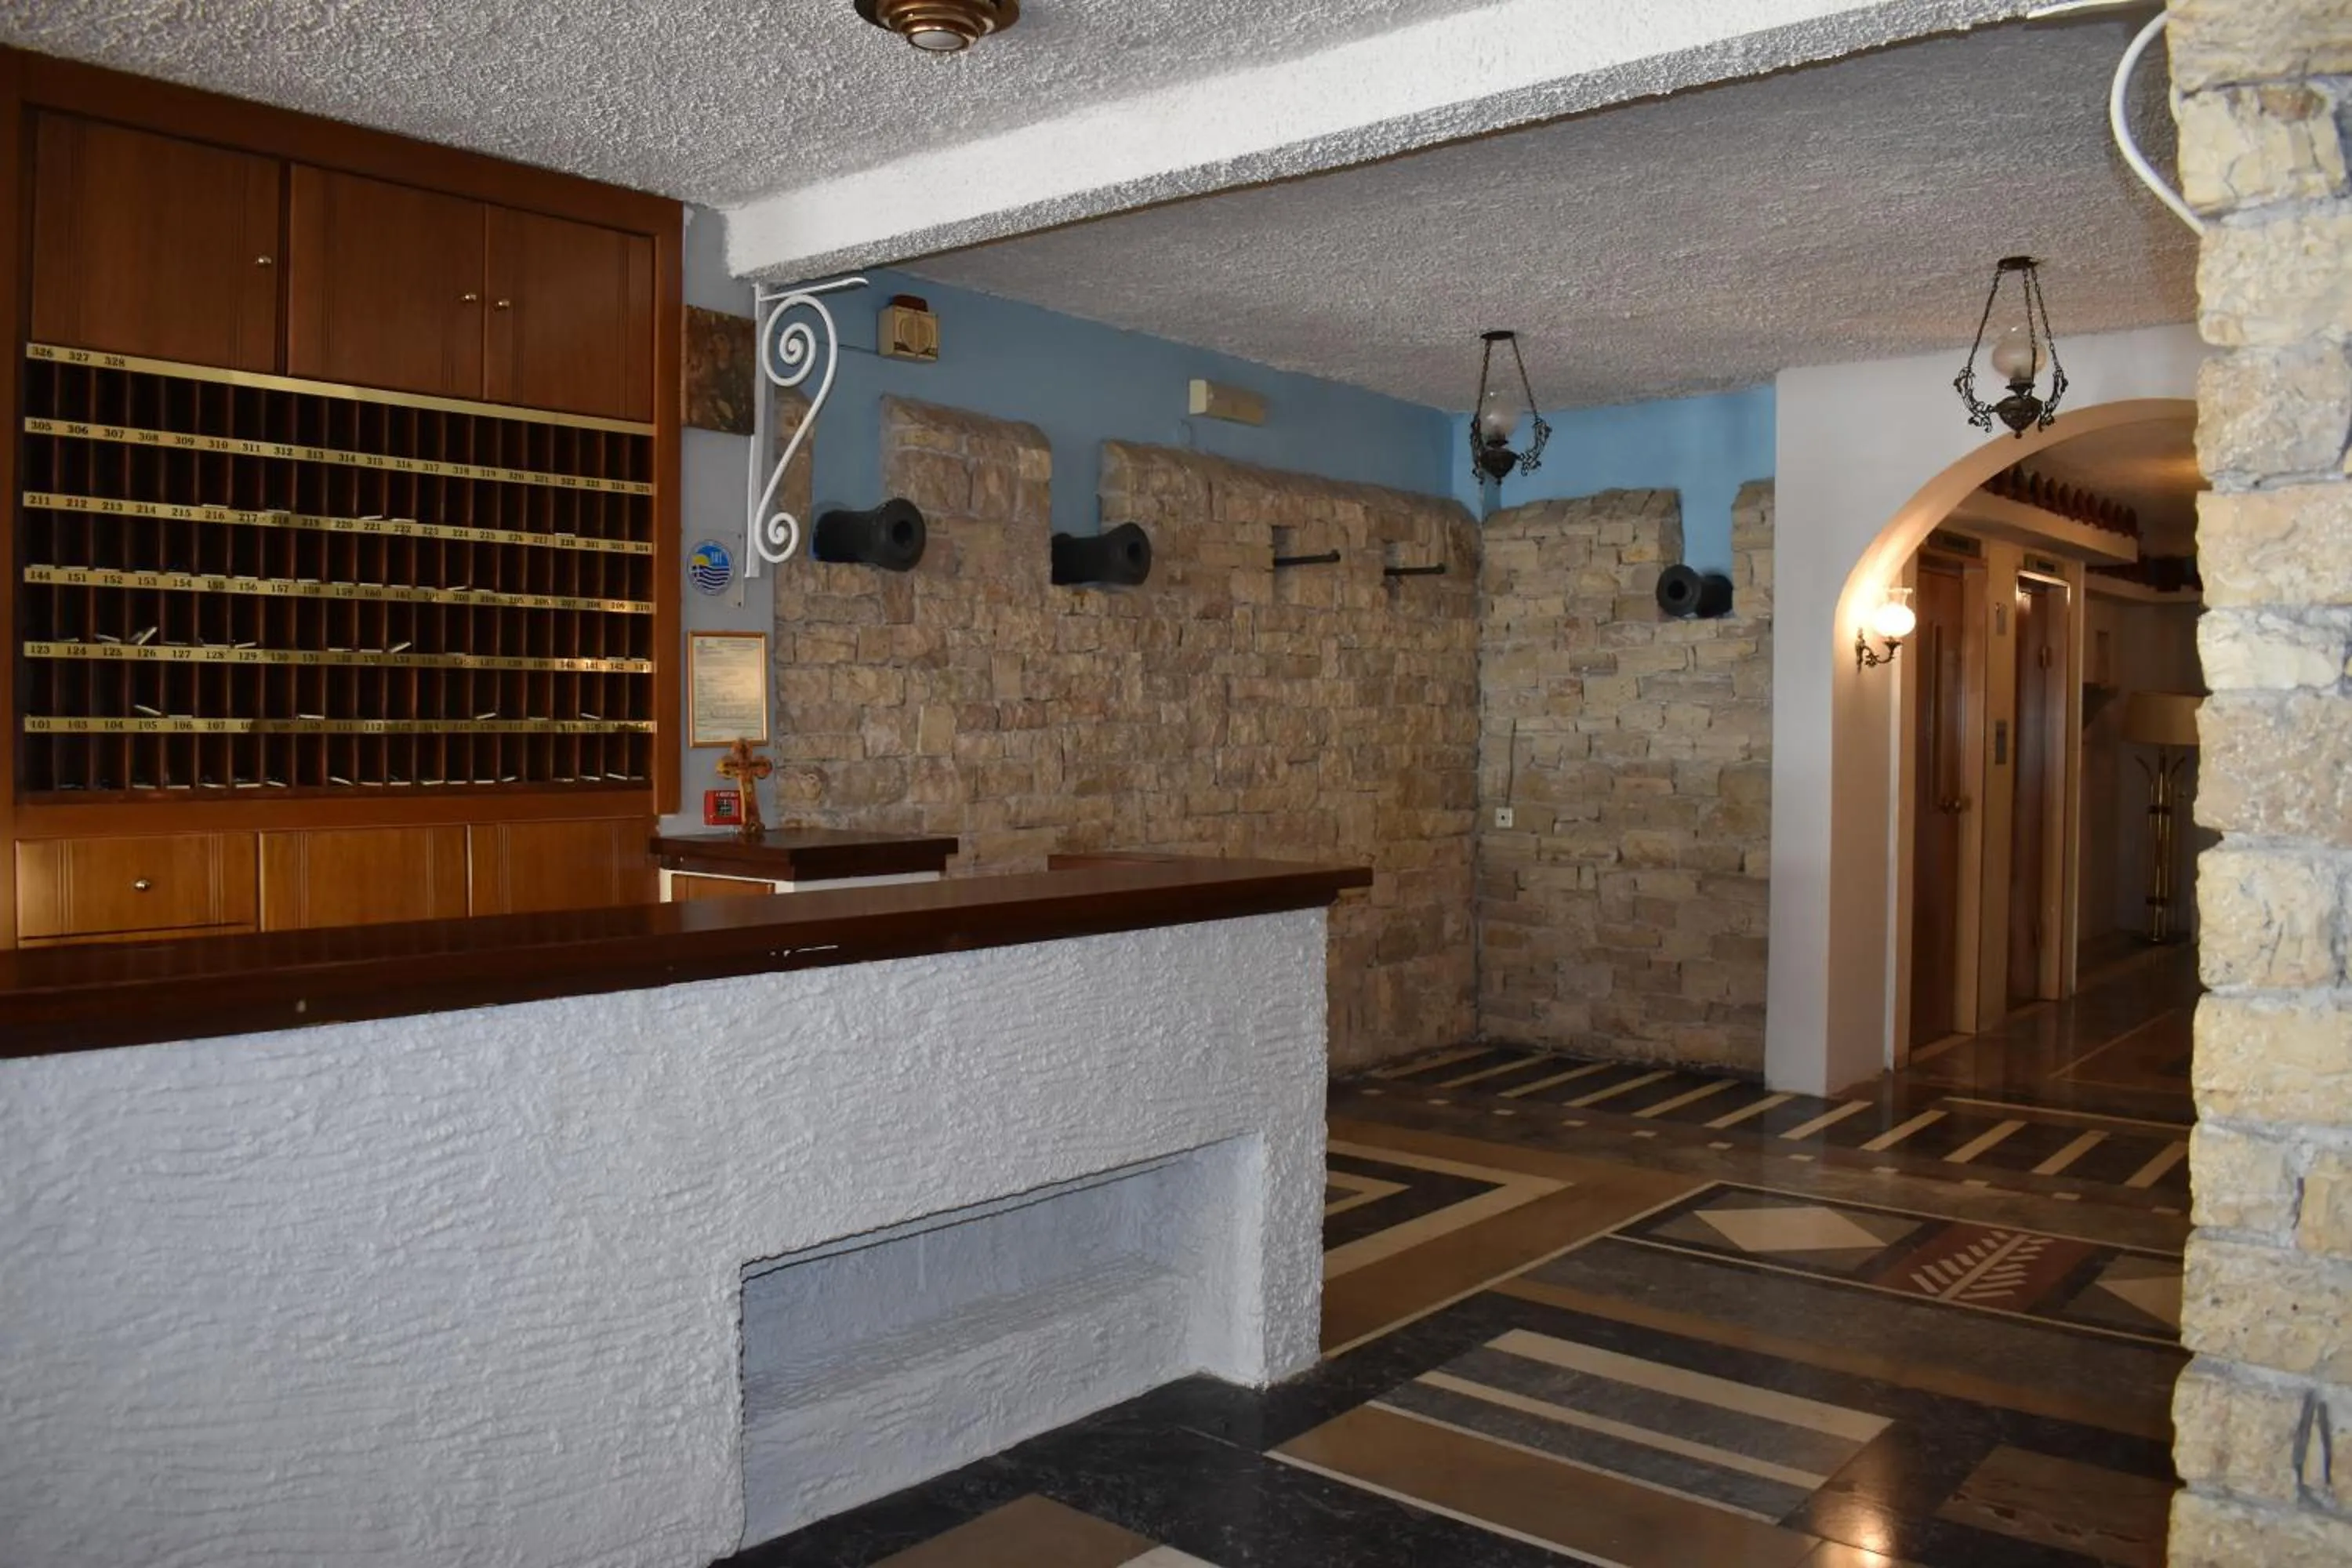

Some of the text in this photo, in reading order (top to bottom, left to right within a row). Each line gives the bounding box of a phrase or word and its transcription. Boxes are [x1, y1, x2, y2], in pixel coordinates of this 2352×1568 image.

[31, 345, 126, 368] 326 327 328
[31, 420, 52, 431] 305
[66, 423, 89, 435] 306
[103, 427, 125, 439] 307
[175, 435, 194, 446] 309
[208, 438, 228, 450] 310
[241, 442, 260, 453] 311
[274, 445, 293, 456] 312
[28, 495, 50, 506] 211
[65, 498, 88, 509] 212
[100, 500, 123, 512] 213
[135, 503, 156, 514] 214
[171, 506, 191, 517] 215
[204, 509, 225, 520] 216
[238, 512, 258, 522] 217
[67, 572, 86, 583] 151
[103, 574, 123, 584] 152
[137, 575, 157, 586] 153
[172, 578, 192, 588] 154
[238, 582, 258, 591] 156
[270, 583, 289, 593] 157
[31, 644, 50, 654] 123
[67, 645, 86, 655] 124
[103, 646, 122, 656] 125
[137, 648, 156, 658] 126
[172, 648, 191, 659] 127
[205, 650, 224, 659] 128
[238, 651, 257, 660] 129
[31, 720, 50, 729] 101
[67, 720, 88, 729] 103
[103, 720, 124, 729] 104
[138, 720, 158, 729] 105
[173, 720, 193, 729] 106
[206, 720, 226, 729] 107
